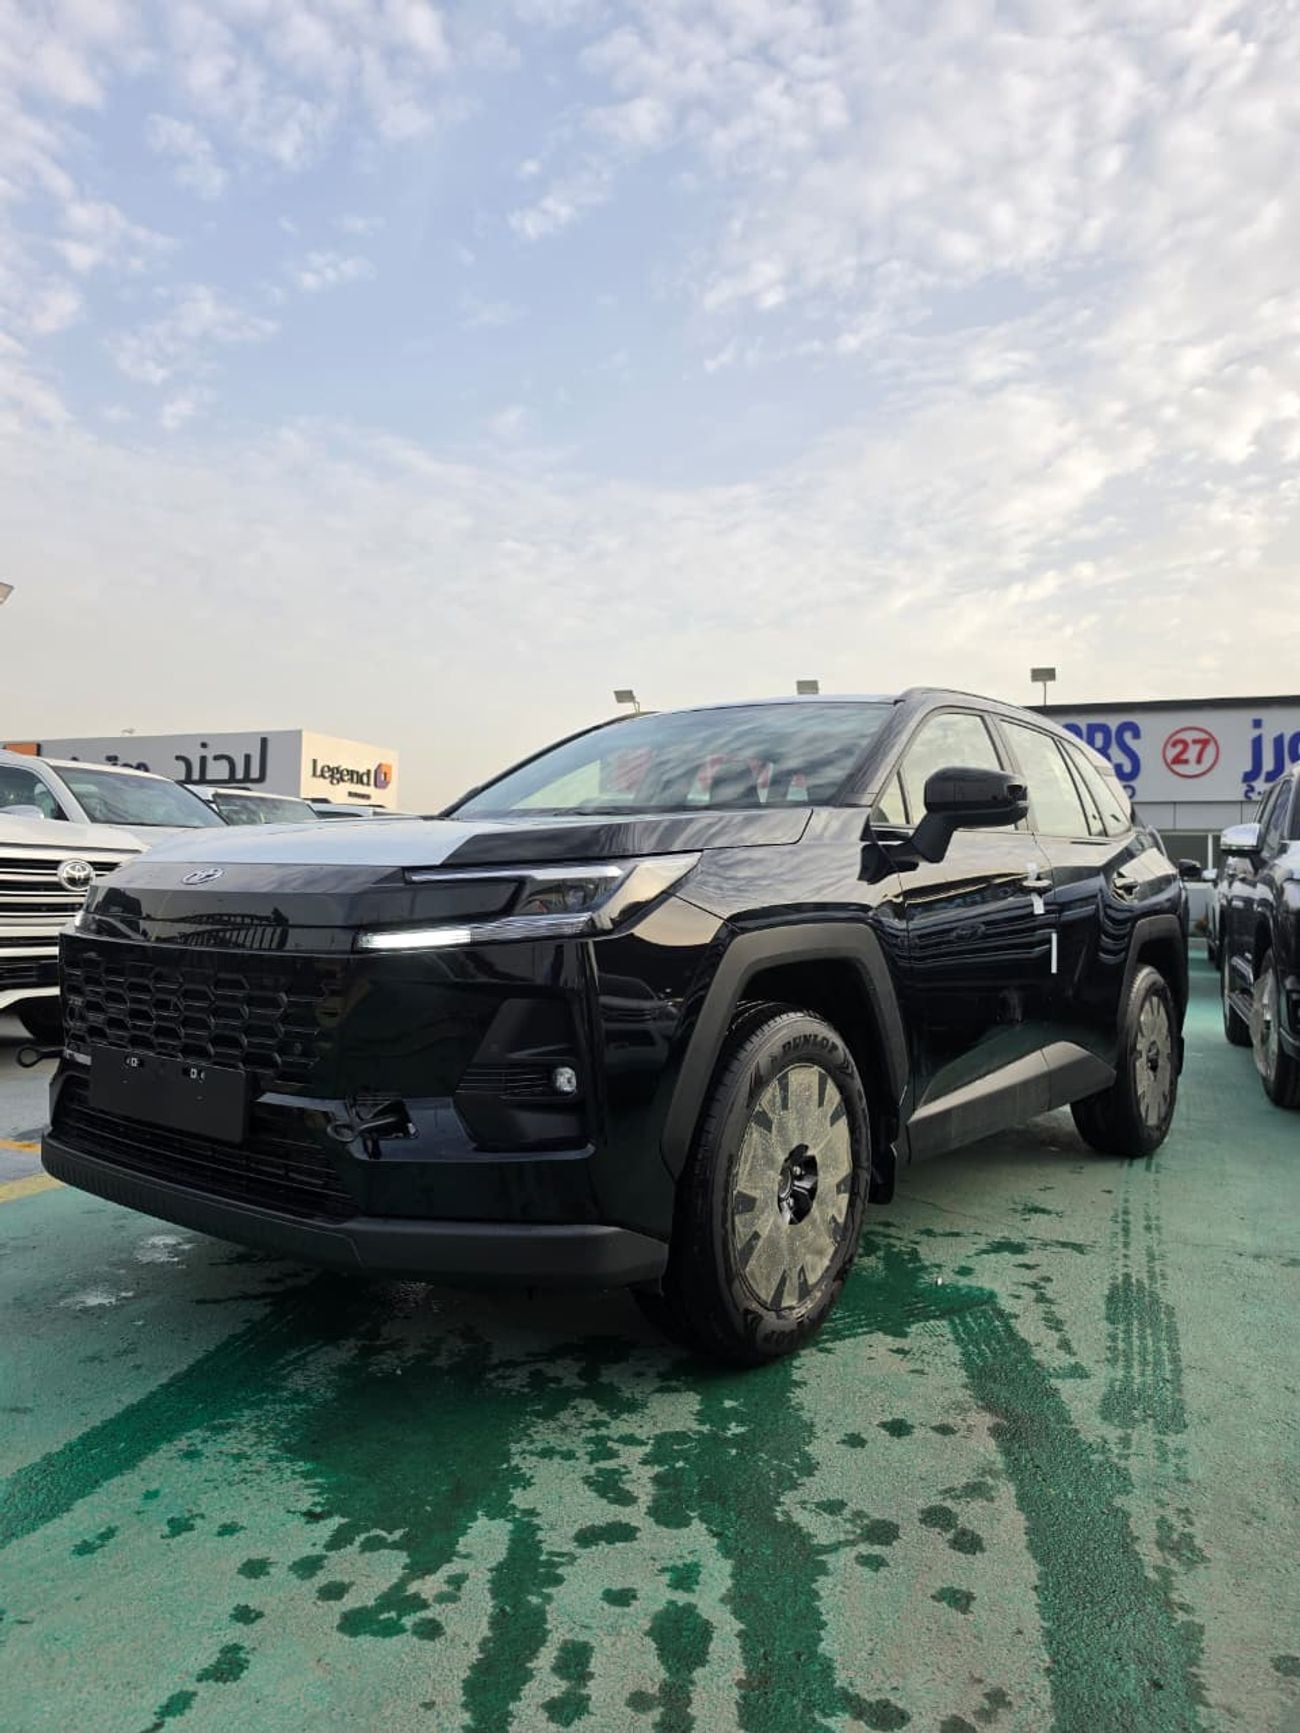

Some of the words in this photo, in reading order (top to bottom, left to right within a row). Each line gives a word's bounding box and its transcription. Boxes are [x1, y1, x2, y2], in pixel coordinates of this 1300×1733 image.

[1170, 737, 1212, 765] 27
[311, 758, 371, 787] Legend
[782, 1033, 839, 1054] DUNLOP
